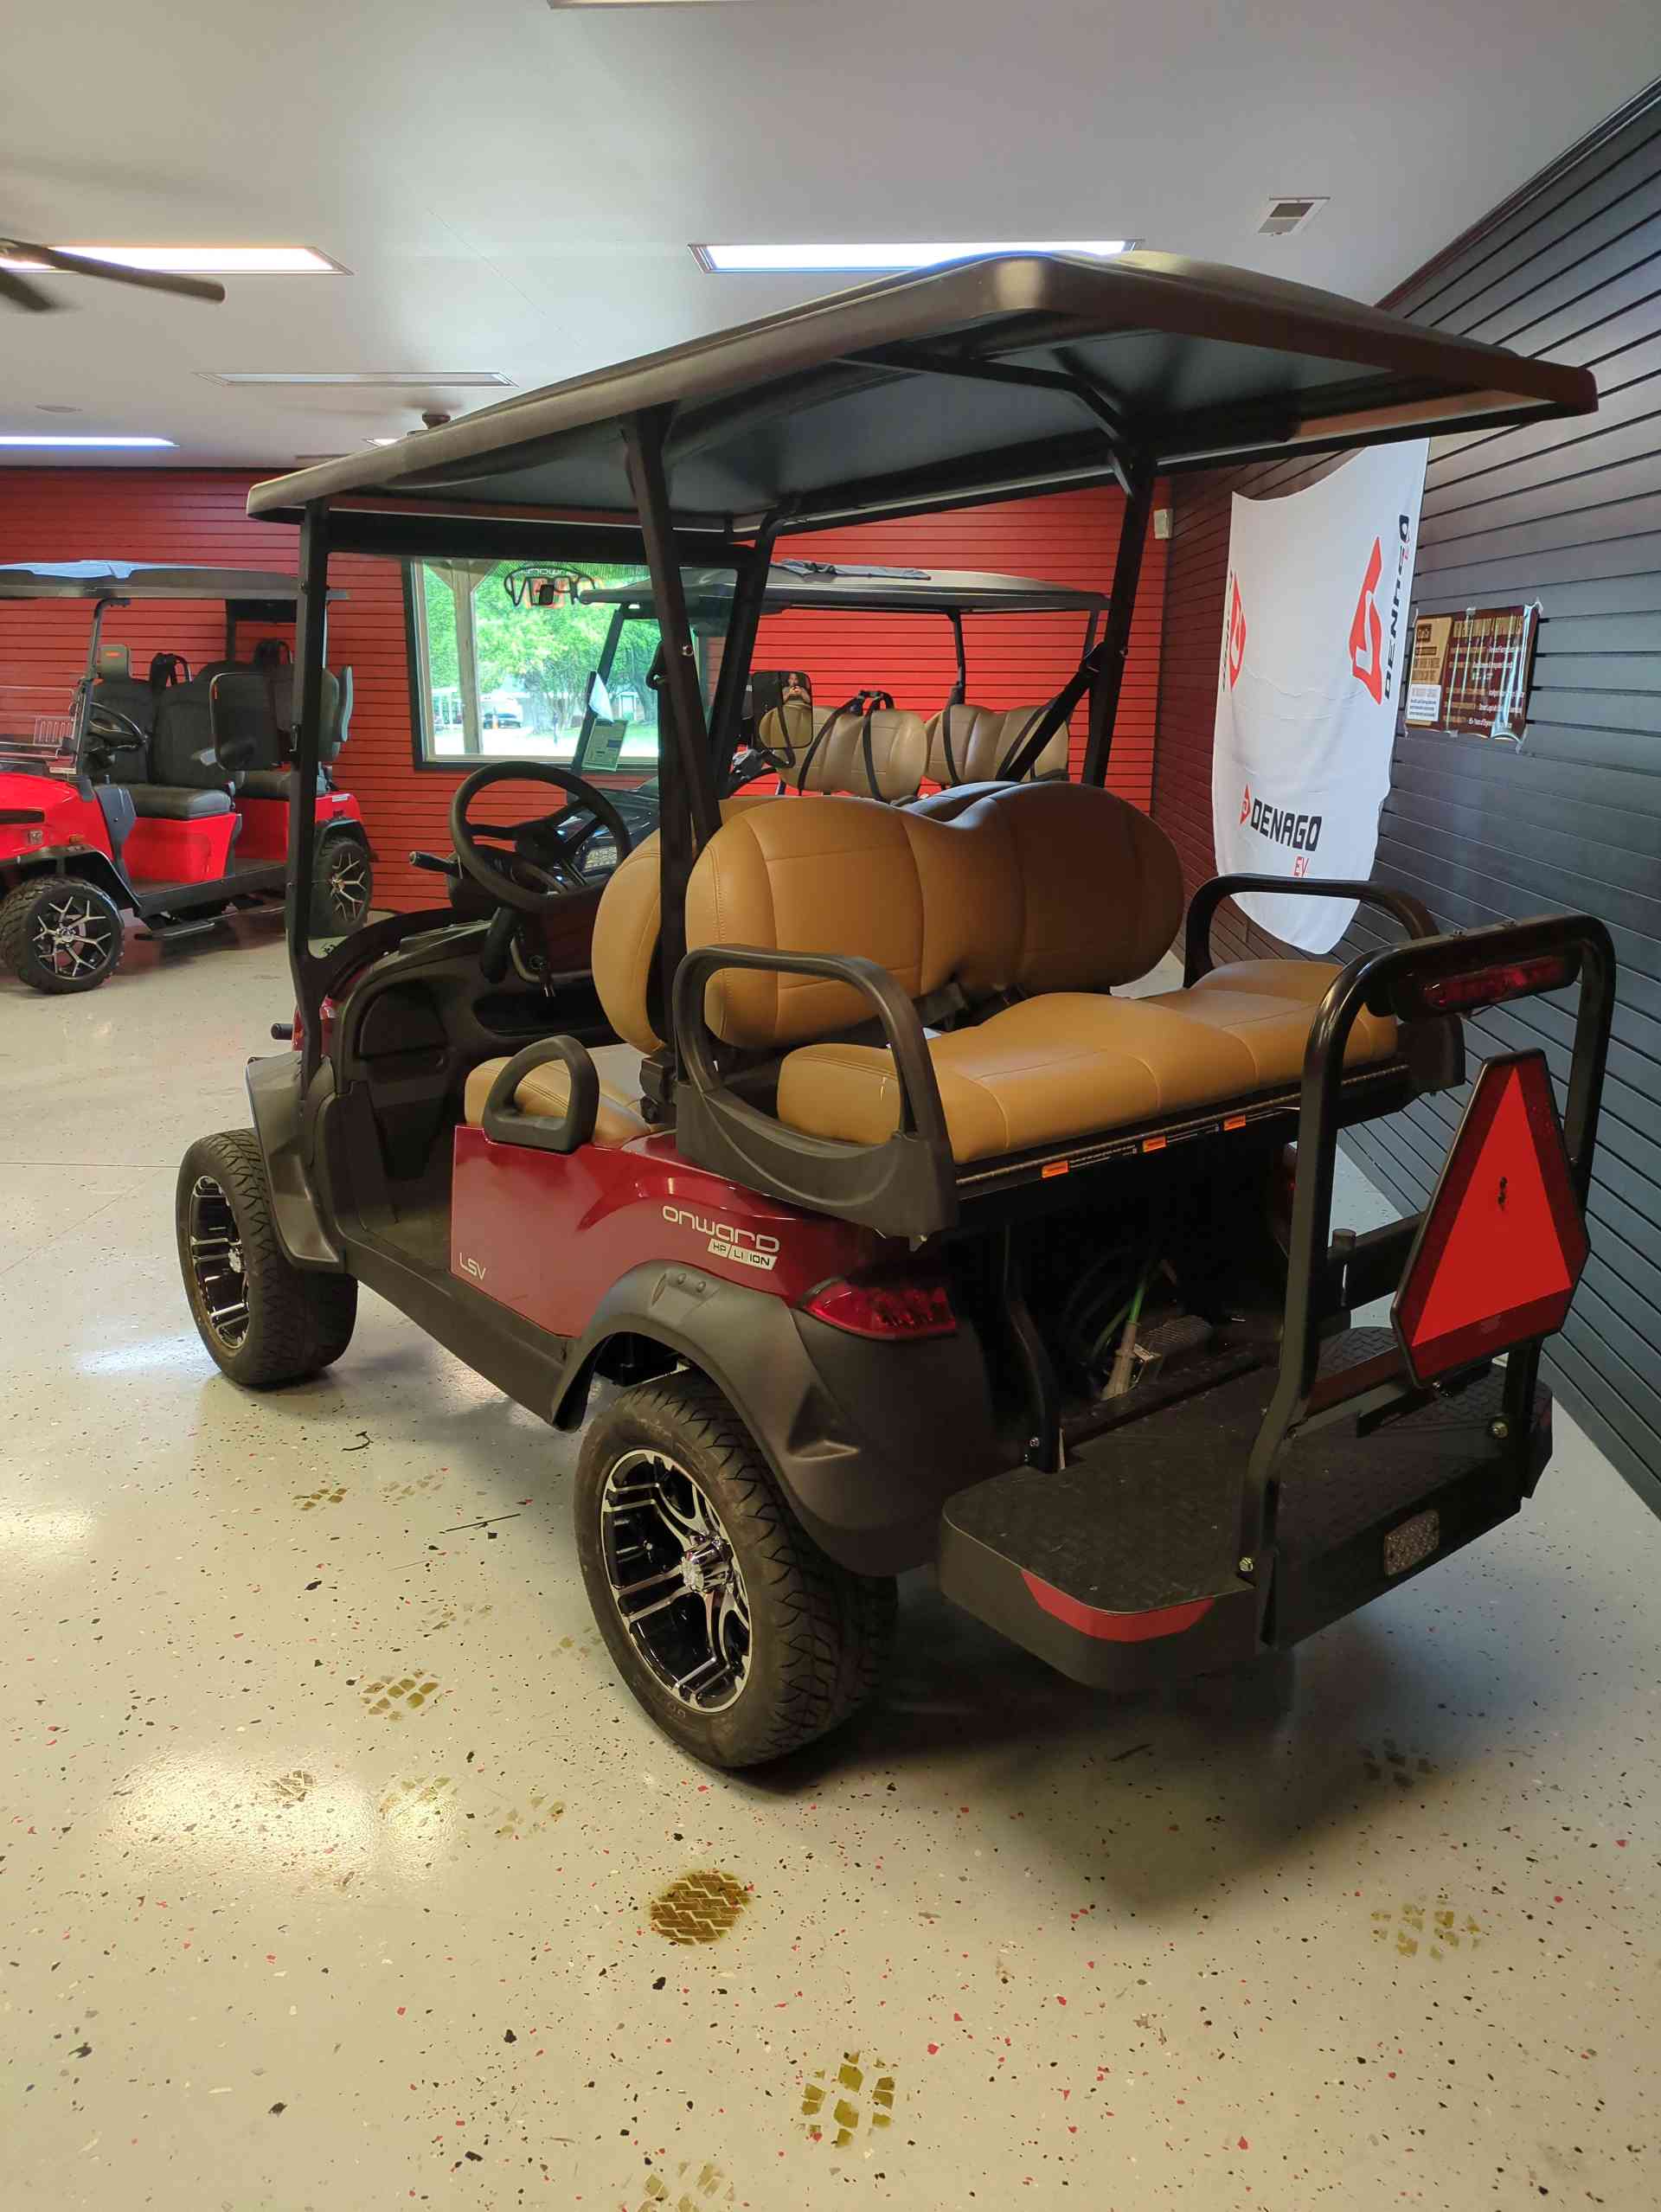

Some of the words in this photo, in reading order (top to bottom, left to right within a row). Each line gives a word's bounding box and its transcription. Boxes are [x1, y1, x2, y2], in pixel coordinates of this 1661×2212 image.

[1250, 798, 1322, 852] DENAGO
[1293, 856, 1310, 877] EV
[459, 1252, 487, 1280] LSV
[713, 1241, 727, 1253] HP
[749, 1252, 771, 1266] ION
